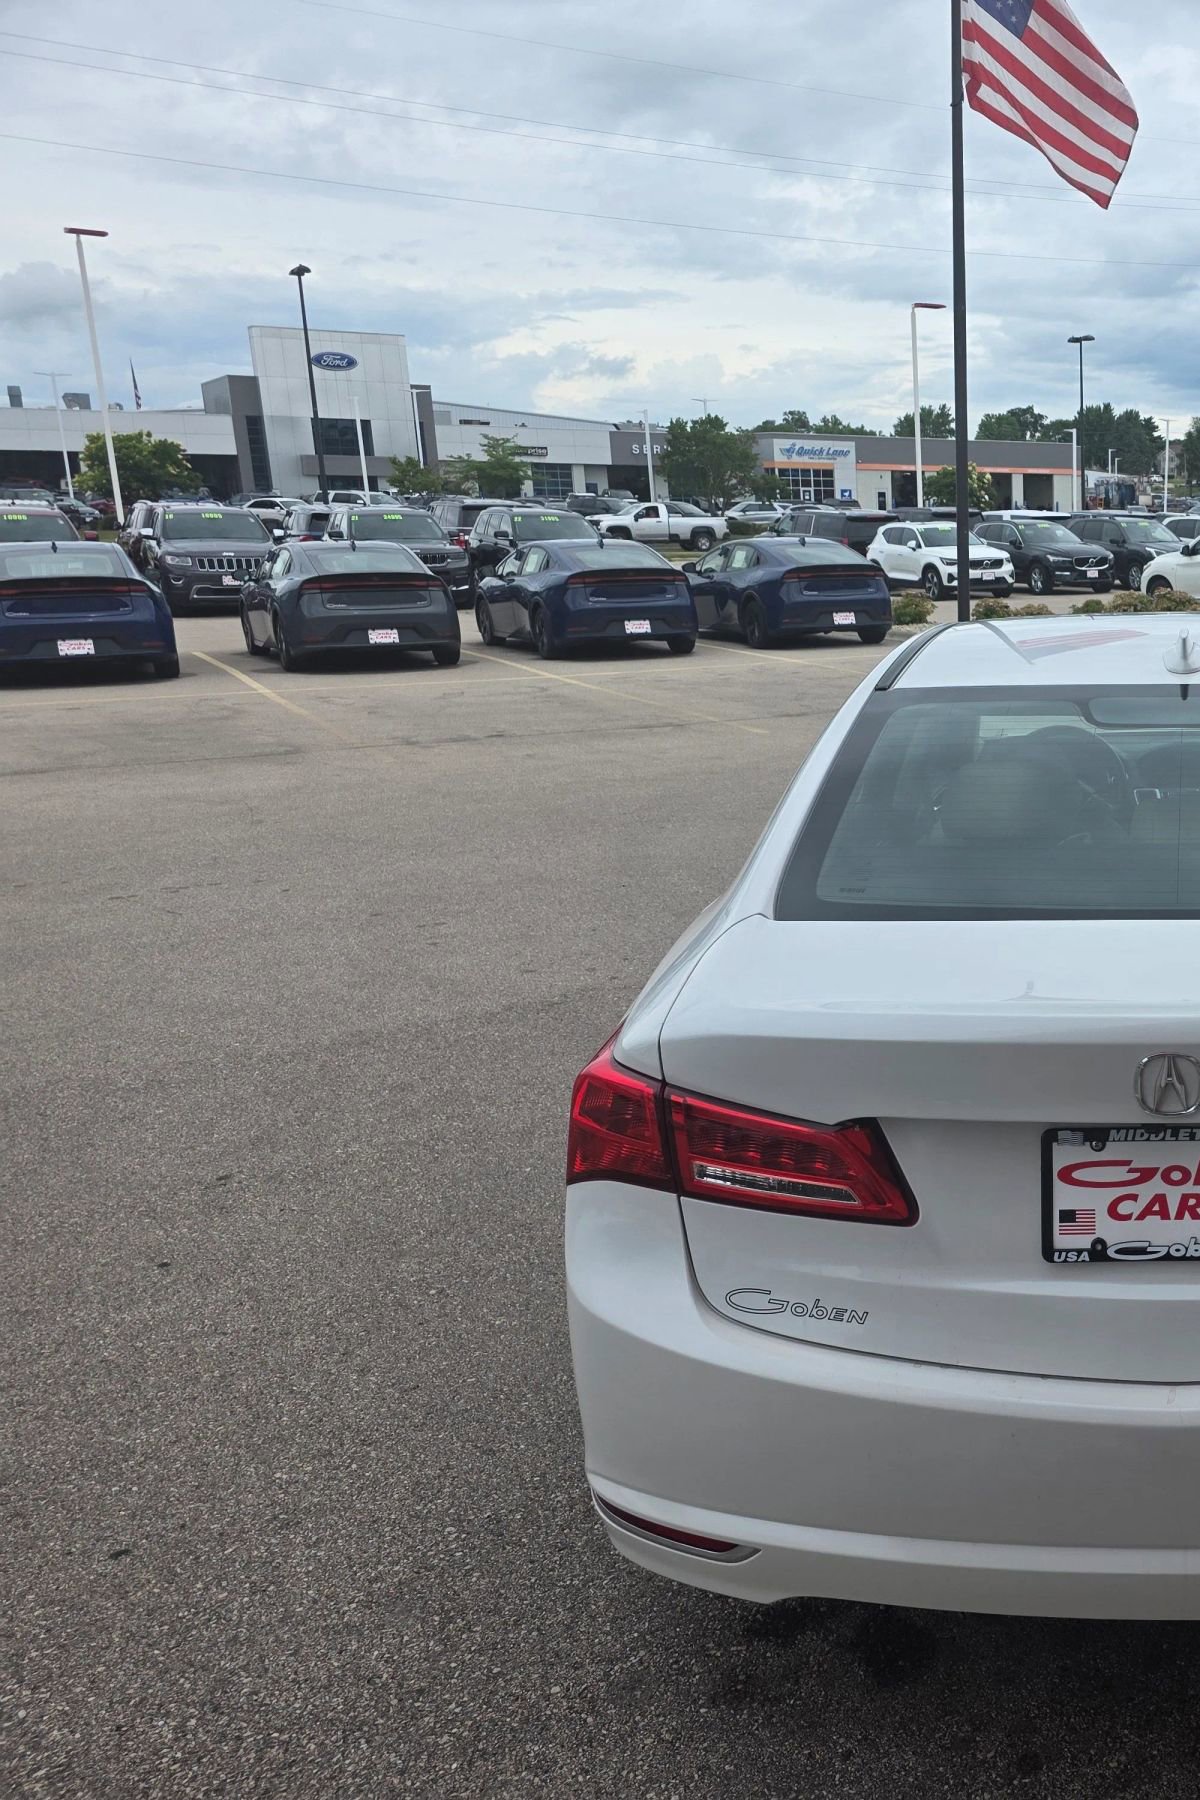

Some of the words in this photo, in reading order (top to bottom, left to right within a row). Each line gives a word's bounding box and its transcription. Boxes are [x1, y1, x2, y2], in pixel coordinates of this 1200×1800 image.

[320, 354, 349, 367] Ford
[795, 446, 825, 457] Quick
[826, 447, 851, 457] Lane
[1052, 1251, 1091, 1263] USA
